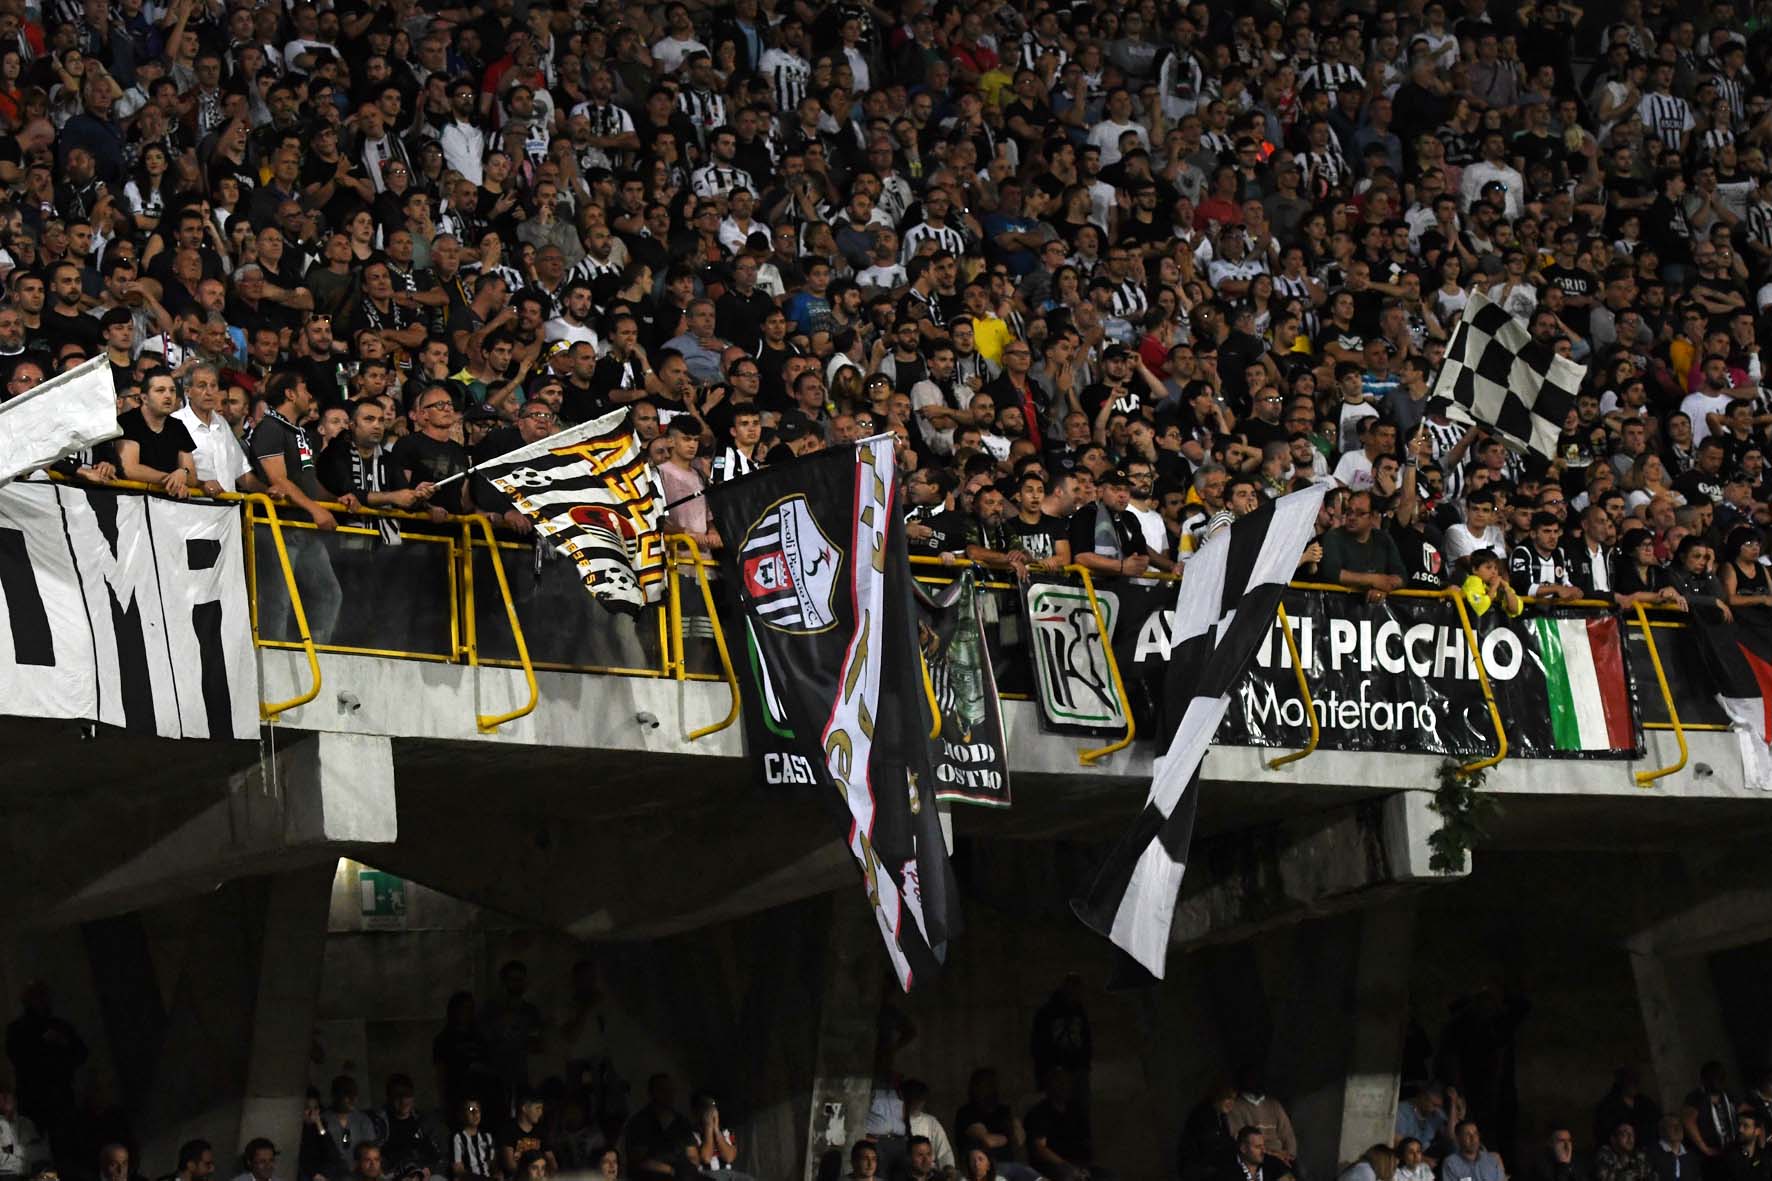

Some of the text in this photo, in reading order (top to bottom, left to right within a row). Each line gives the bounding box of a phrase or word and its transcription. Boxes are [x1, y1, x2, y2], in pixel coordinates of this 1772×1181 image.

[781, 507, 797, 549] Ascoli
[1411, 570, 1442, 588] ASCO
[1330, 618, 1523, 681] PICCHIO
[1247, 680, 1437, 732] Montefano
